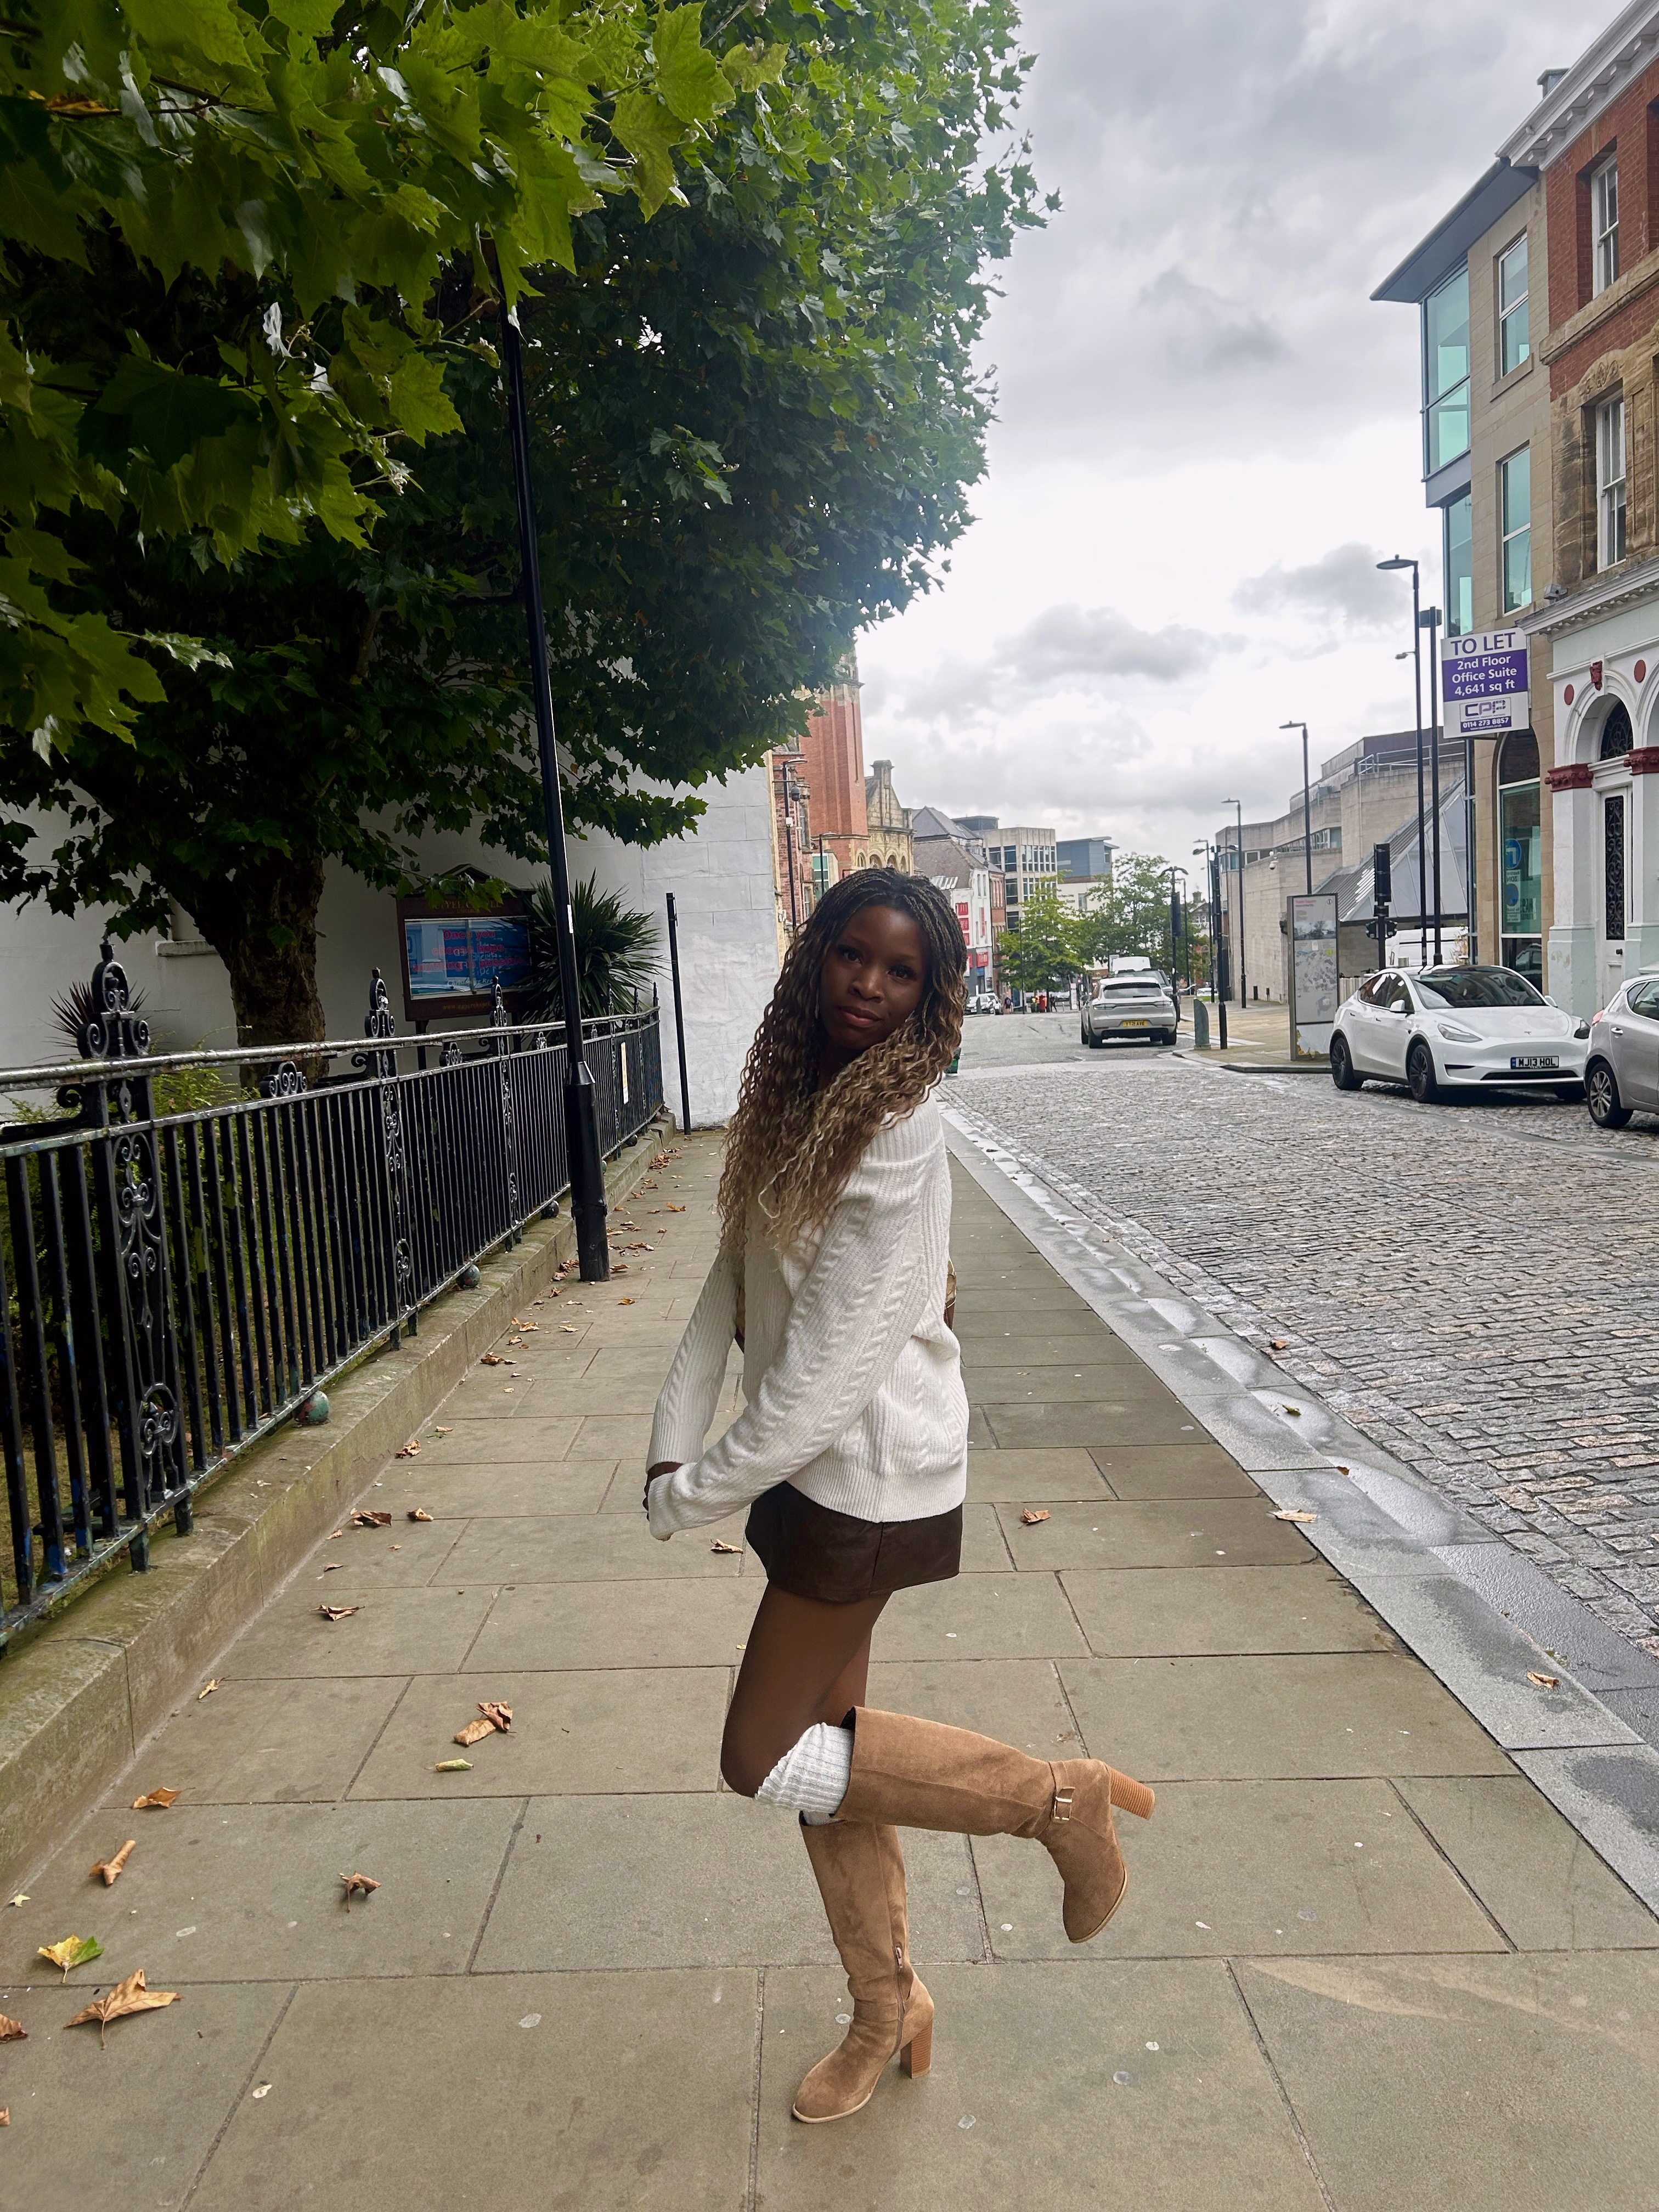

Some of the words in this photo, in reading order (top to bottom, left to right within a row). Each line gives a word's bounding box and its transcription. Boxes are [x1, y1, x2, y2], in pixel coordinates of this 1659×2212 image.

[1451, 638, 1477, 656] TO
[1483, 632, 1516, 651] LET
[1457, 658, 1479, 670] 2nd
[1482, 656, 1511, 667] Floor
[1452, 672, 1485, 684] Office
[1488, 667, 1517, 679] Suite
[1454, 683, 1485, 696] 4,641
[1489, 683, 1502, 692] sq
[1505, 679, 1515, 689] ft
[1463, 719, 1476, 729] 0114
[1478, 718, 1491, 727] 273
[1492, 717, 1509, 725] 8857
[443, 929, 472, 940] Once
[476, 929, 496, 940] you
[412, 960, 463, 974] anything
[1519, 1058, 1538, 1067] MJ13
[1539, 1058, 1556, 1066] HOL
